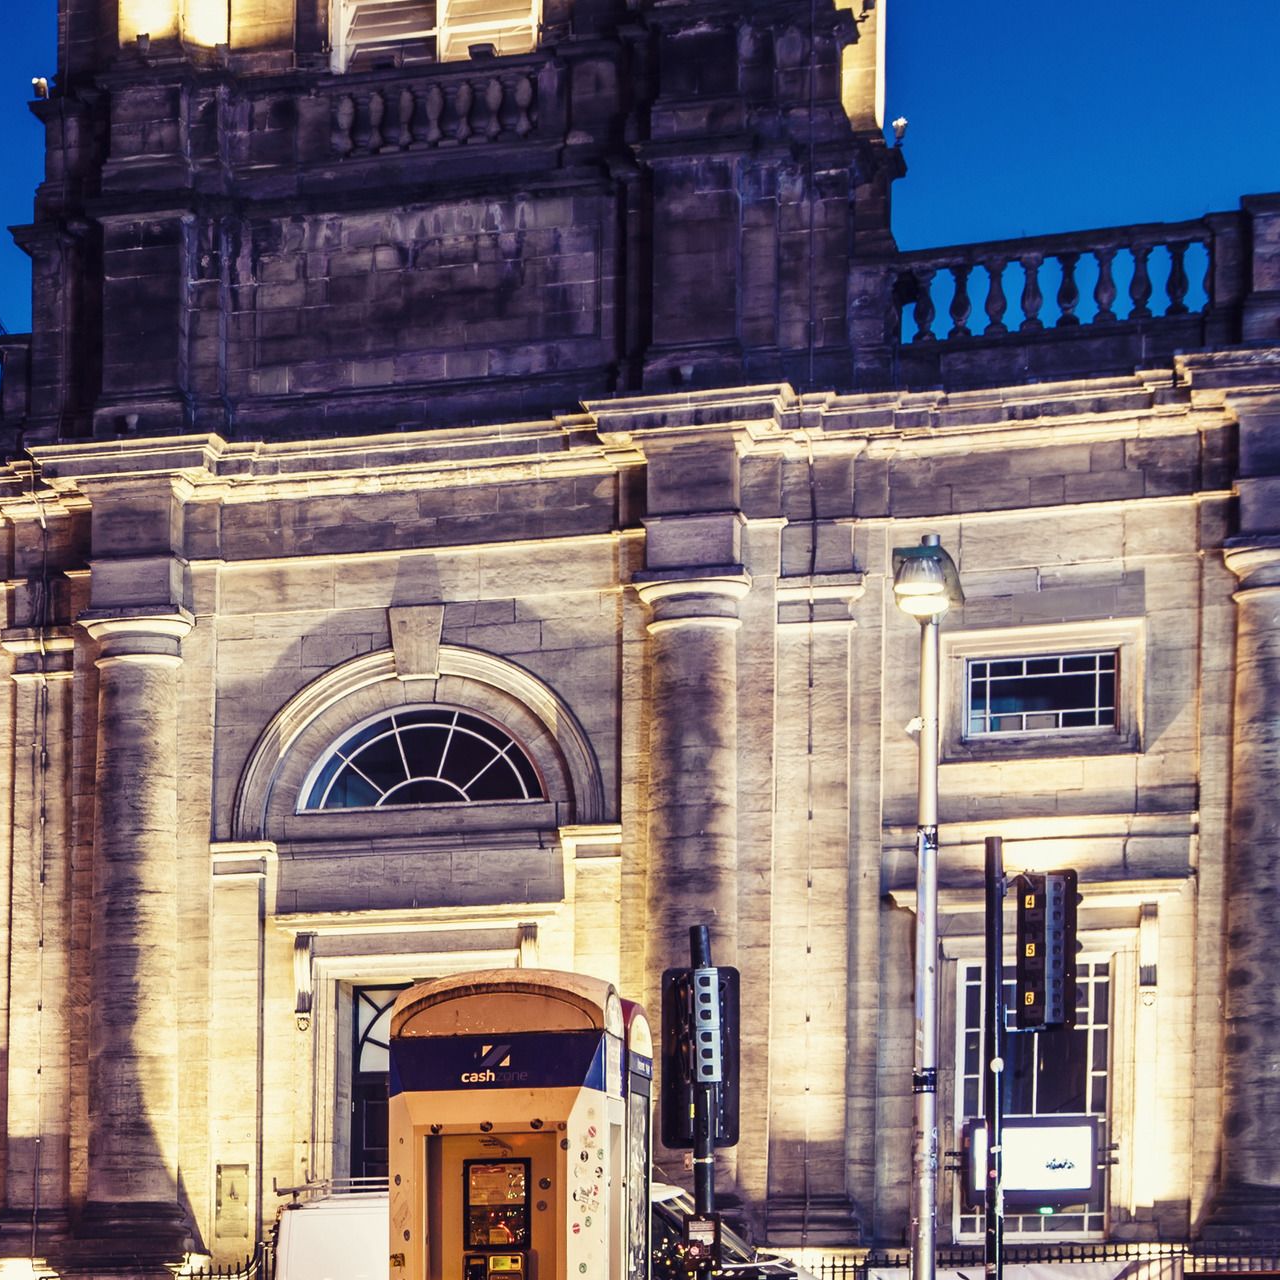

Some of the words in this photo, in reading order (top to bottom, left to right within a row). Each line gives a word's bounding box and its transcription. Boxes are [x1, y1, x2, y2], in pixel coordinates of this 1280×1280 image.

[1026, 897, 1033, 907] 4
[1027, 944, 1034, 954] 5
[1026, 994, 1033, 1003] 6
